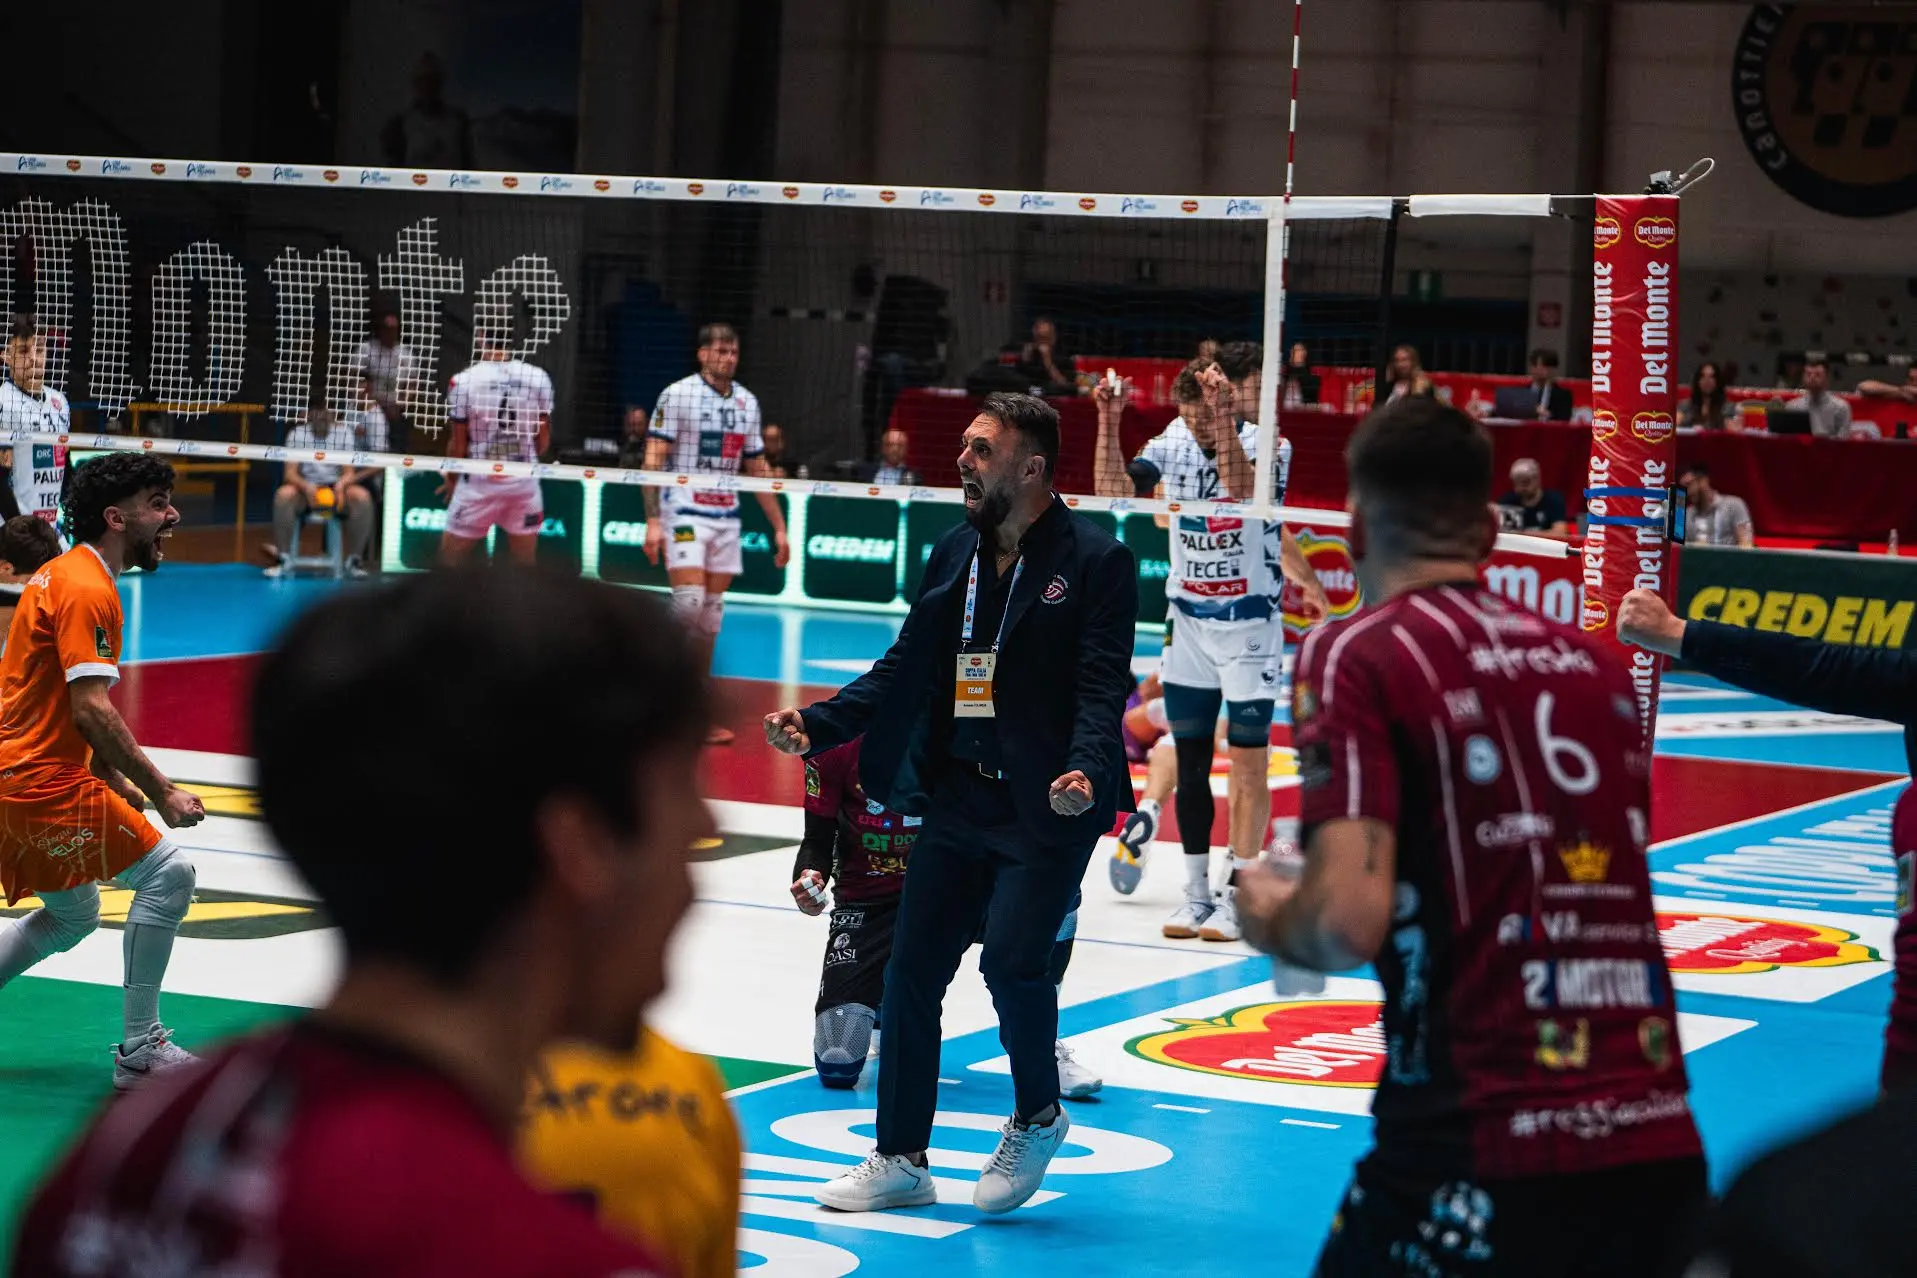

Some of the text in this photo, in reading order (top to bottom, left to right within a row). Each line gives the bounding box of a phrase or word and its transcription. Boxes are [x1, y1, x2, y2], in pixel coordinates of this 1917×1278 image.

[1638, 225, 1674, 236] Del Monte
[1640, 260, 1670, 395] Del Monte
[1634, 420, 1672, 431] Del Monte
[1196, 467, 1219, 499] 12
[807, 534, 896, 563] CREDEM
[1180, 531, 1244, 552] PALLEX
[1186, 560, 1229, 579] TECE
[1184, 580, 1243, 595] POLAR
[1688, 586, 1915, 648] CREDEM
[1535, 690, 1600, 796] 6
